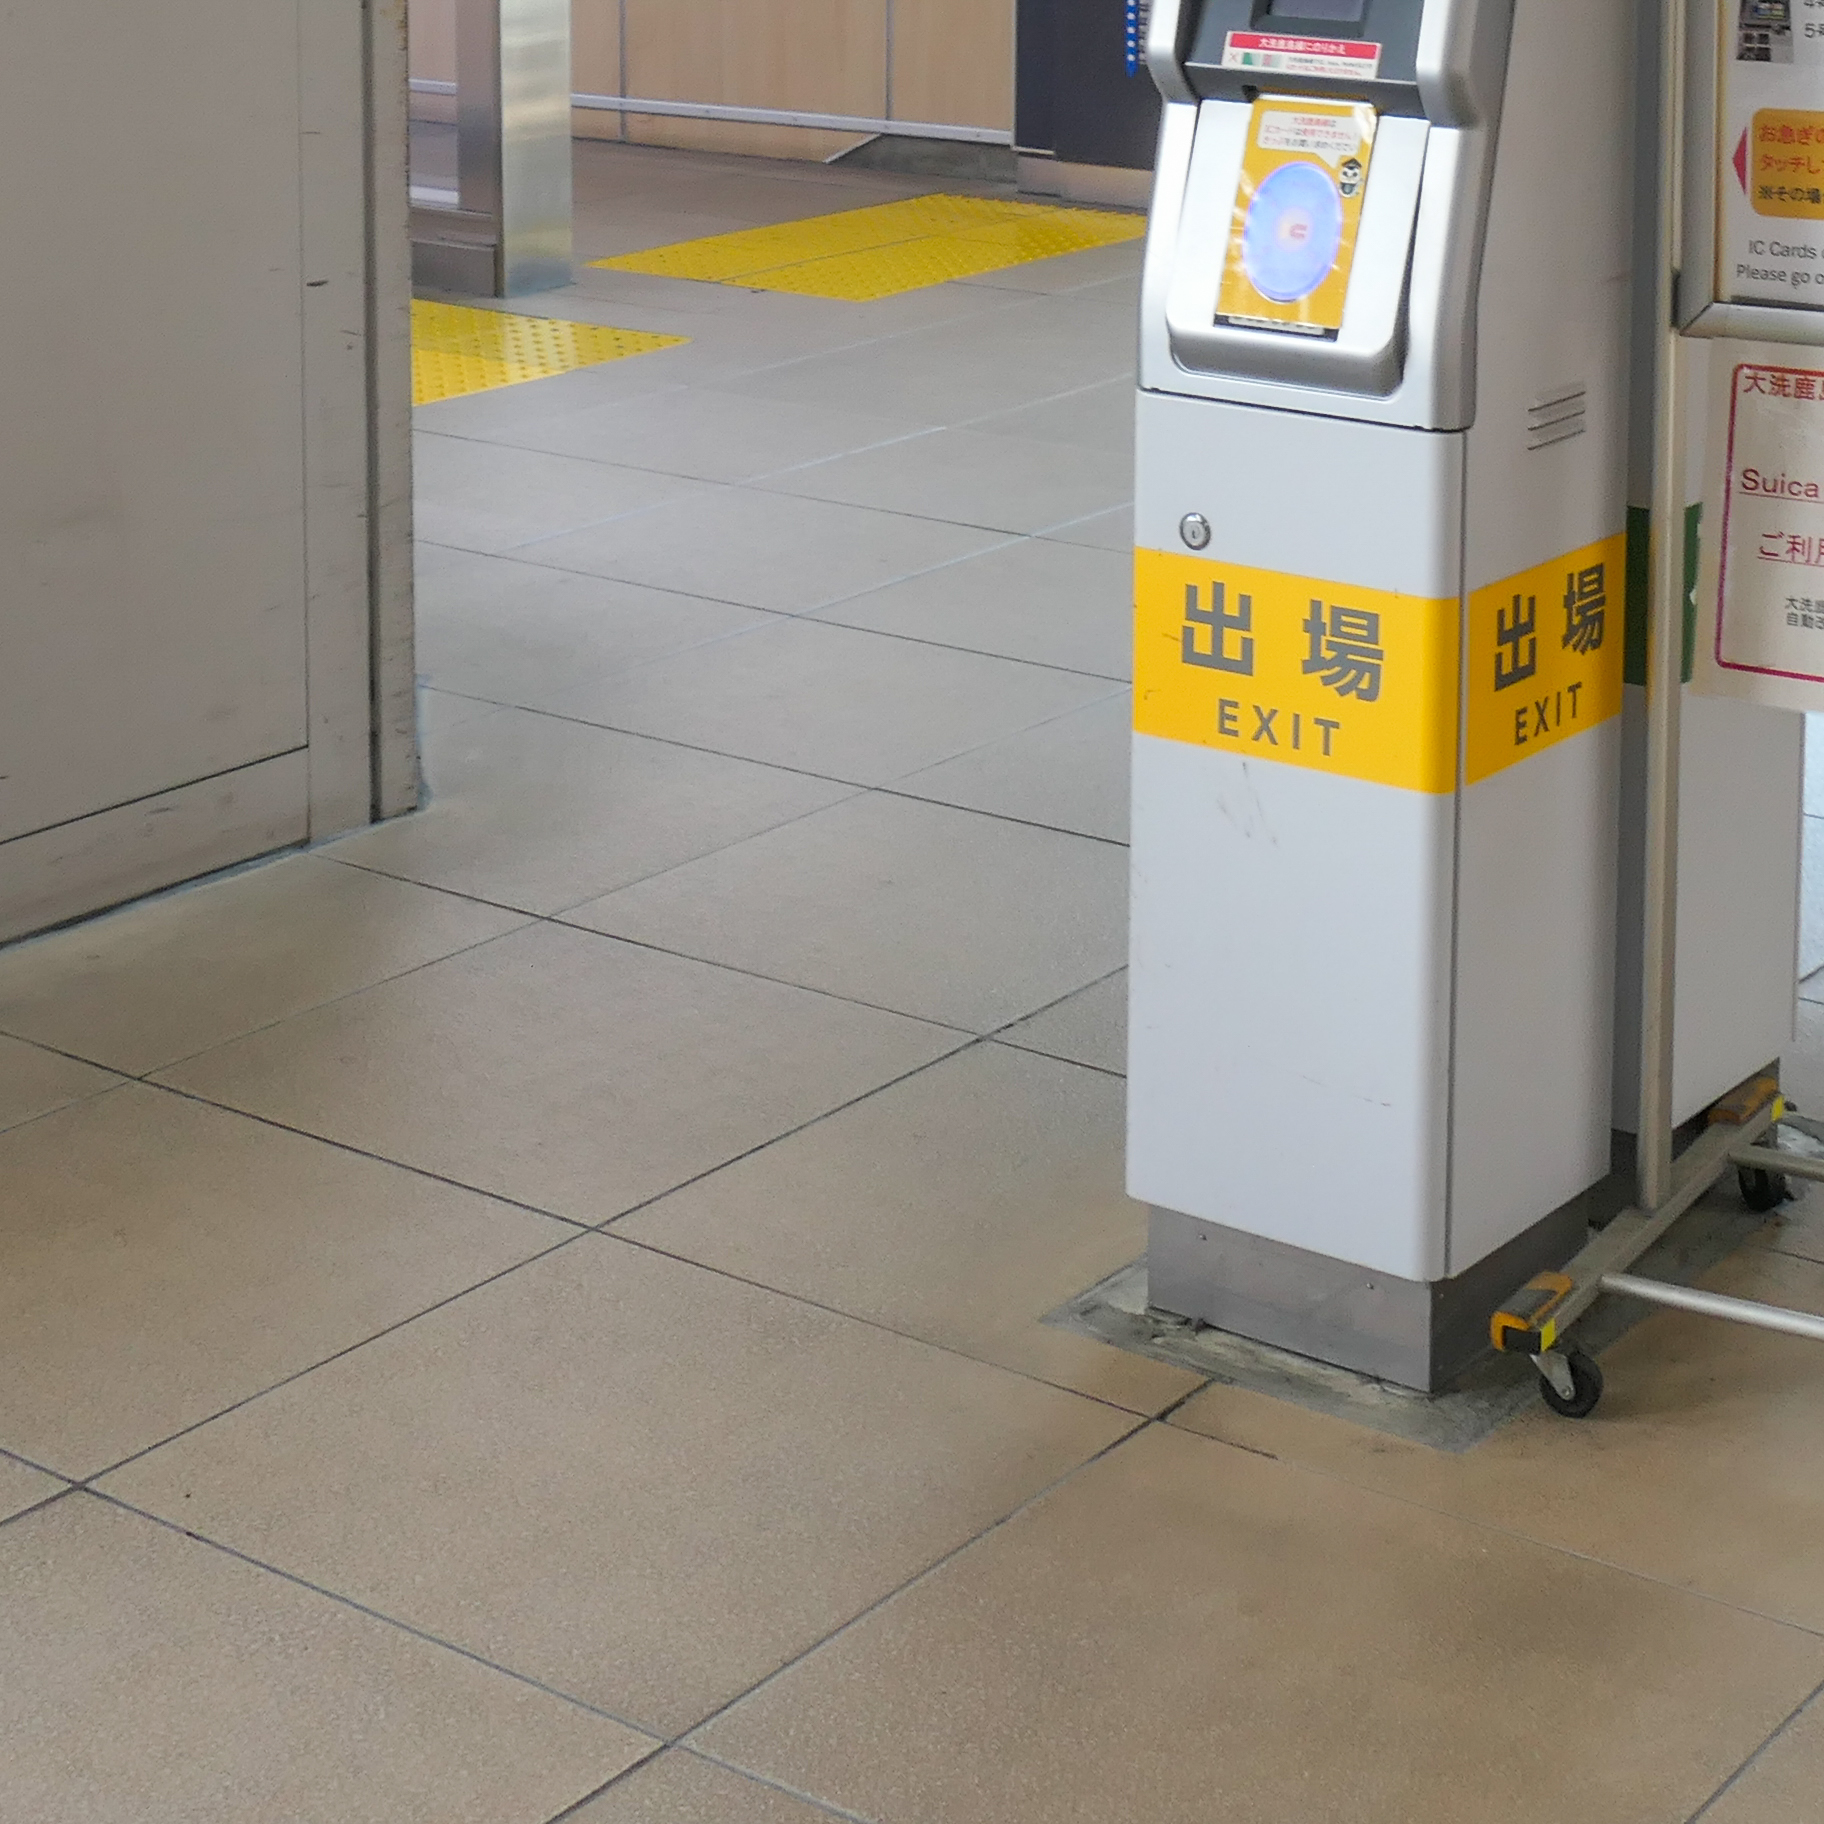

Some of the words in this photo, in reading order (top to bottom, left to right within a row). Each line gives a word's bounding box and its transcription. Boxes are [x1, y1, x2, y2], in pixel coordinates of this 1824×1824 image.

[1735, 263, 1787, 282] Please
[1791, 270, 1811, 290] go
[1748, 239, 1765, 255] IC
[1768, 241, 1817, 260] Cards
[1181, 581, 1384, 703] 出場
[1493, 562, 1607, 693] 出場
[1217, 698, 1341, 757] EXIT
[1514, 680, 1584, 747] EXIT
